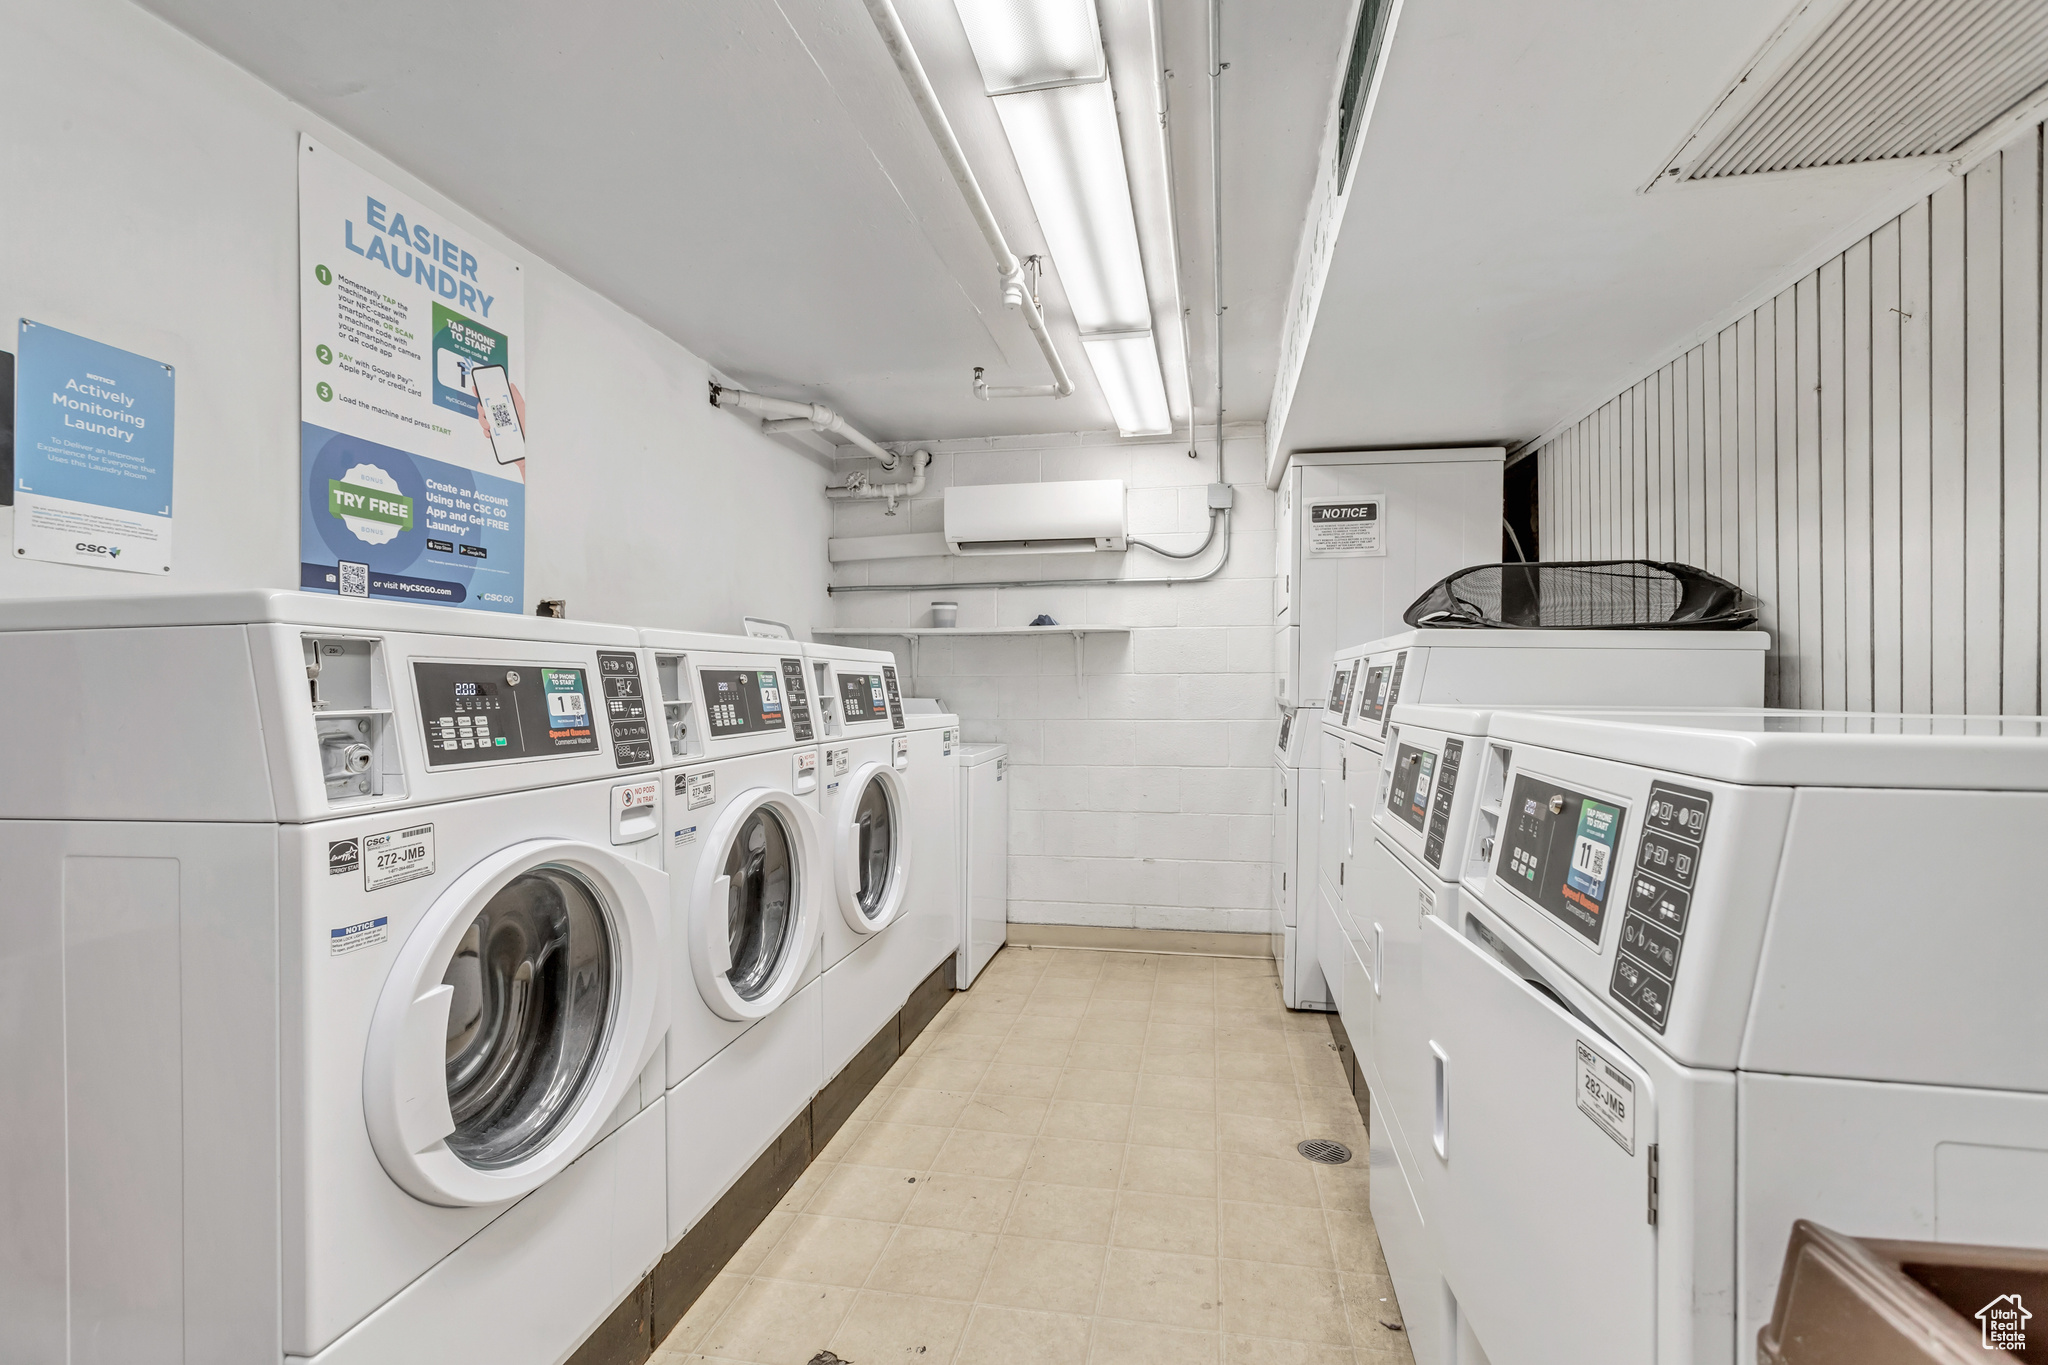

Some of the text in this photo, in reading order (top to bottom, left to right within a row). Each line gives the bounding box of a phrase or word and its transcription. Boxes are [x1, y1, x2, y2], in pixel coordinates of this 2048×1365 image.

[367, 195, 478, 283] EASIER
[320, 269, 326, 281] 1
[345, 219, 494, 318] LAUNDRY
[338, 274, 408, 312] Momentarily TAP the
[338, 284, 407, 320] machine sticker with
[338, 294, 400, 325] your NFC-capable
[338, 322, 421, 360] your smartphone camera
[344, 314, 374, 332] machine
[376, 328, 392, 340] code
[394, 336, 407, 346] with
[383, 322, 394, 332] OR
[395, 327, 414, 340] SCAN
[446, 318, 496, 348] TAP PHONE
[348, 334, 360, 344] QR
[361, 340, 378, 352] code
[380, 348, 392, 358] app
[450, 330, 492, 356] TO START
[320, 349, 328, 362] 2
[338, 352, 353, 362] PAY
[354, 360, 370, 370] with
[372, 365, 396, 379] Google
[86, 373, 116, 386] NOTICE
[338, 362, 360, 375] Apple
[387, 380, 406, 392] credit
[408, 387, 422, 398] card
[65, 378, 135, 408] Actively
[320, 386, 328, 398] 3
[52, 392, 146, 429] Monitoring
[338, 394, 452, 436] Load the machine and press START
[64, 414, 134, 443] Laundry
[37, 442, 156, 474] Experience for Everyone that
[51, 436, 145, 464] To Deliver an Improved
[48, 454, 148, 480] Uses this Laundry Room
[360, 474, 384, 484] BONUS
[333, 489, 408, 518] TRY FREE
[426, 479, 508, 506] Create an Account
[426, 492, 506, 518] Using the CSC GO
[1322, 507, 1368, 518] NOTICE
[426, 506, 510, 531] App and Get FREE
[360, 526, 384, 536] BONUS
[75, 542, 108, 554] CSC
[466, 549, 478, 557] Google
[383, 581, 398, 590] visit
[400, 583, 452, 596] MyCSCGO.com
[484, 592, 514, 604] CSC GO
[558, 696, 565, 712] 1
[765, 690, 770, 702] 2
[548, 728, 591, 740] Speed Queen
[642, 786, 655, 794] PODS
[642, 795, 654, 804] TRAY
[1586, 816, 1610, 832] TO START
[1587, 808, 1613, 824] TAP PHONE
[366, 837, 384, 846] CSC
[377, 846, 426, 868] 272-JMB
[1580, 842, 1592, 869] 11
[346, 920, 375, 934] NOTICE
[1585, 912, 1596, 926] Dryer
[1578, 1046, 1592, 1062] CSC
[1585, 1074, 1626, 1118] 282-JMB
